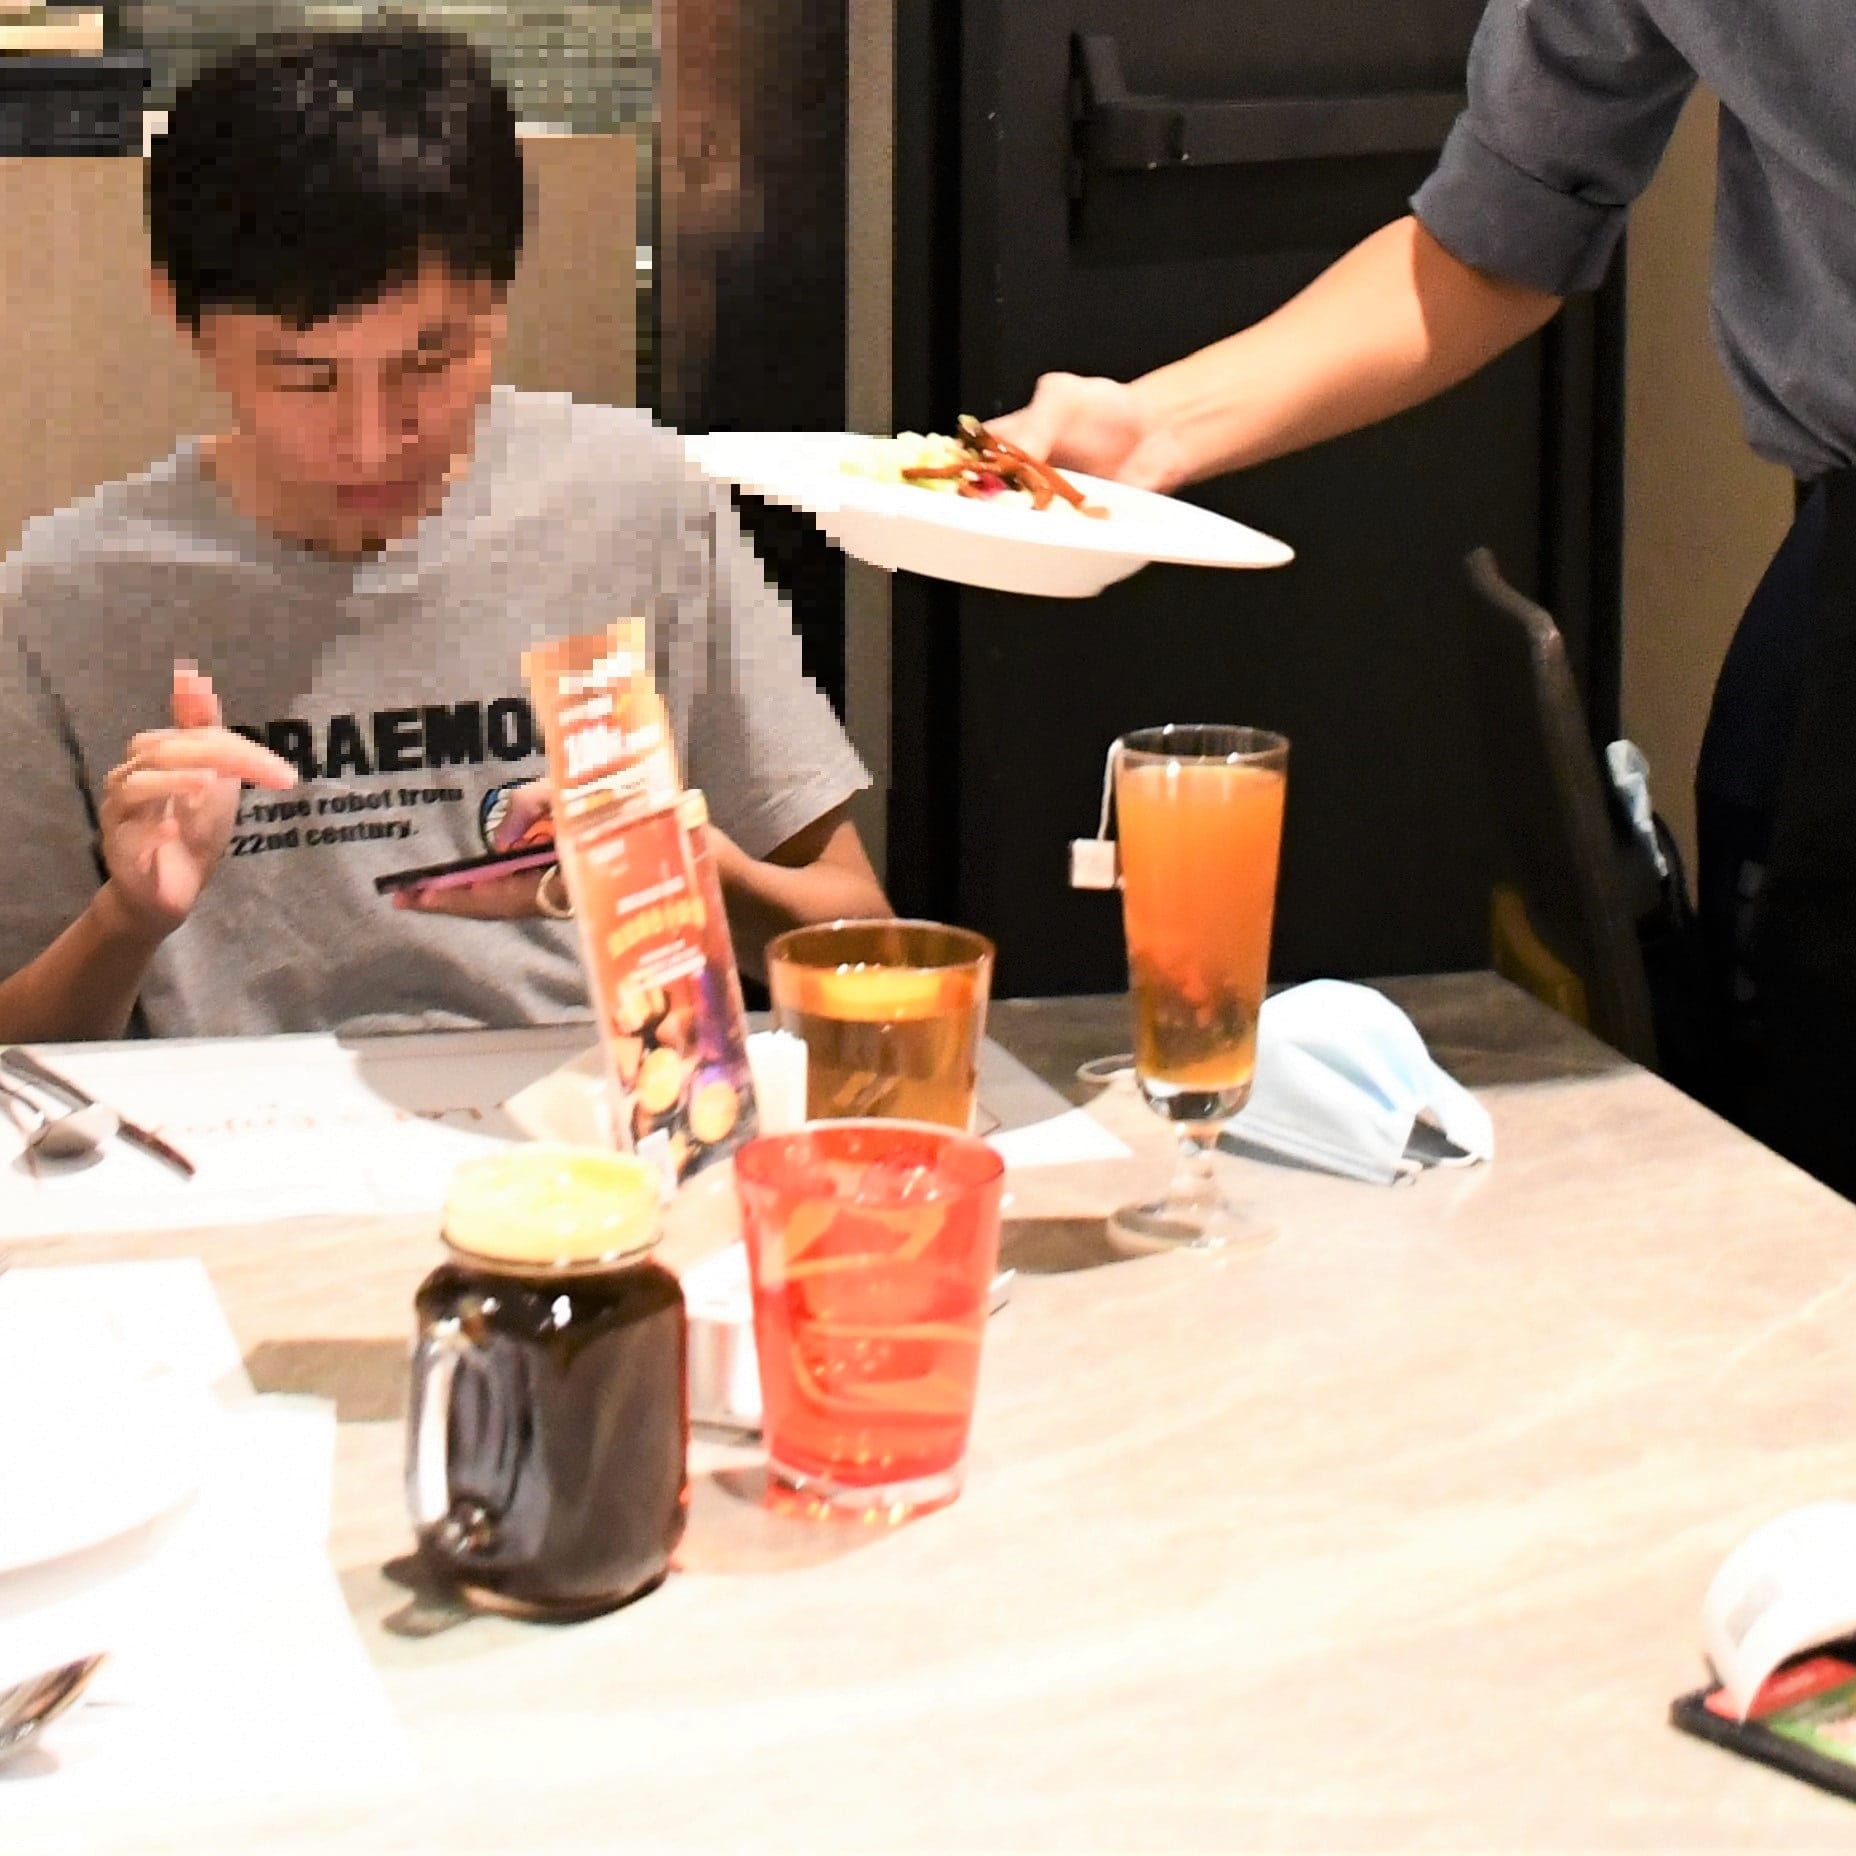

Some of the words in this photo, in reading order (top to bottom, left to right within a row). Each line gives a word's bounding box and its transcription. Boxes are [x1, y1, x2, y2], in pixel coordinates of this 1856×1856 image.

[227, 697, 545, 789] RAEMO
[318, 788, 391, 816] robot
[398, 787, 464, 807] from
[230, 828, 299, 857] 22nd
